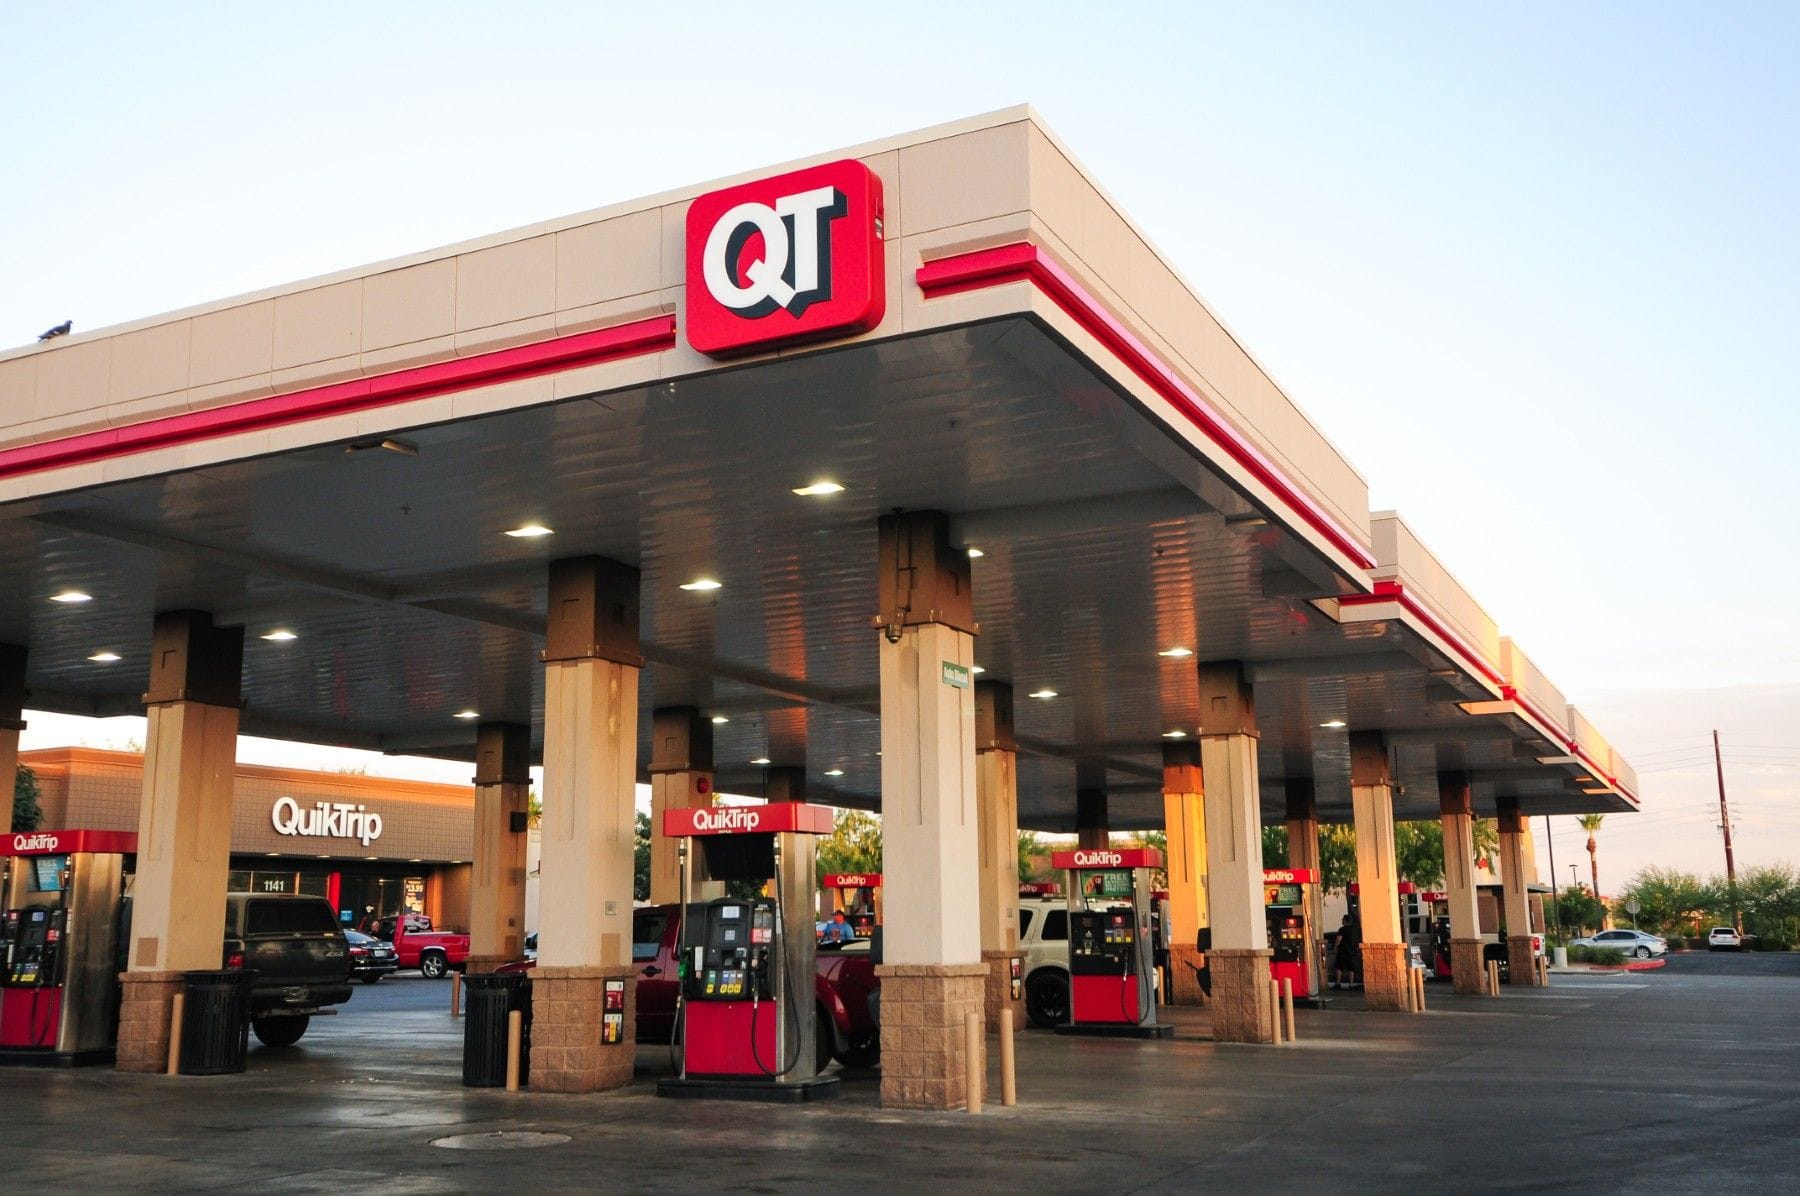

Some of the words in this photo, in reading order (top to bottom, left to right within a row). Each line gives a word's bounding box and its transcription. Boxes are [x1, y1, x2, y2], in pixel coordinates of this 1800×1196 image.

[703, 186, 840, 315] QT
[272, 796, 383, 847] QuikTrip
[692, 809, 760, 831] QuikTrip
[13, 834, 59, 852] QuikTrip
[1074, 851, 1122, 867] QuikTrip
[836, 876, 867, 887] QuikTrip
[1104, 873, 1128, 881] FREE
[1263, 871, 1294, 883] uikTrip
[263, 880, 285, 892] 1141
